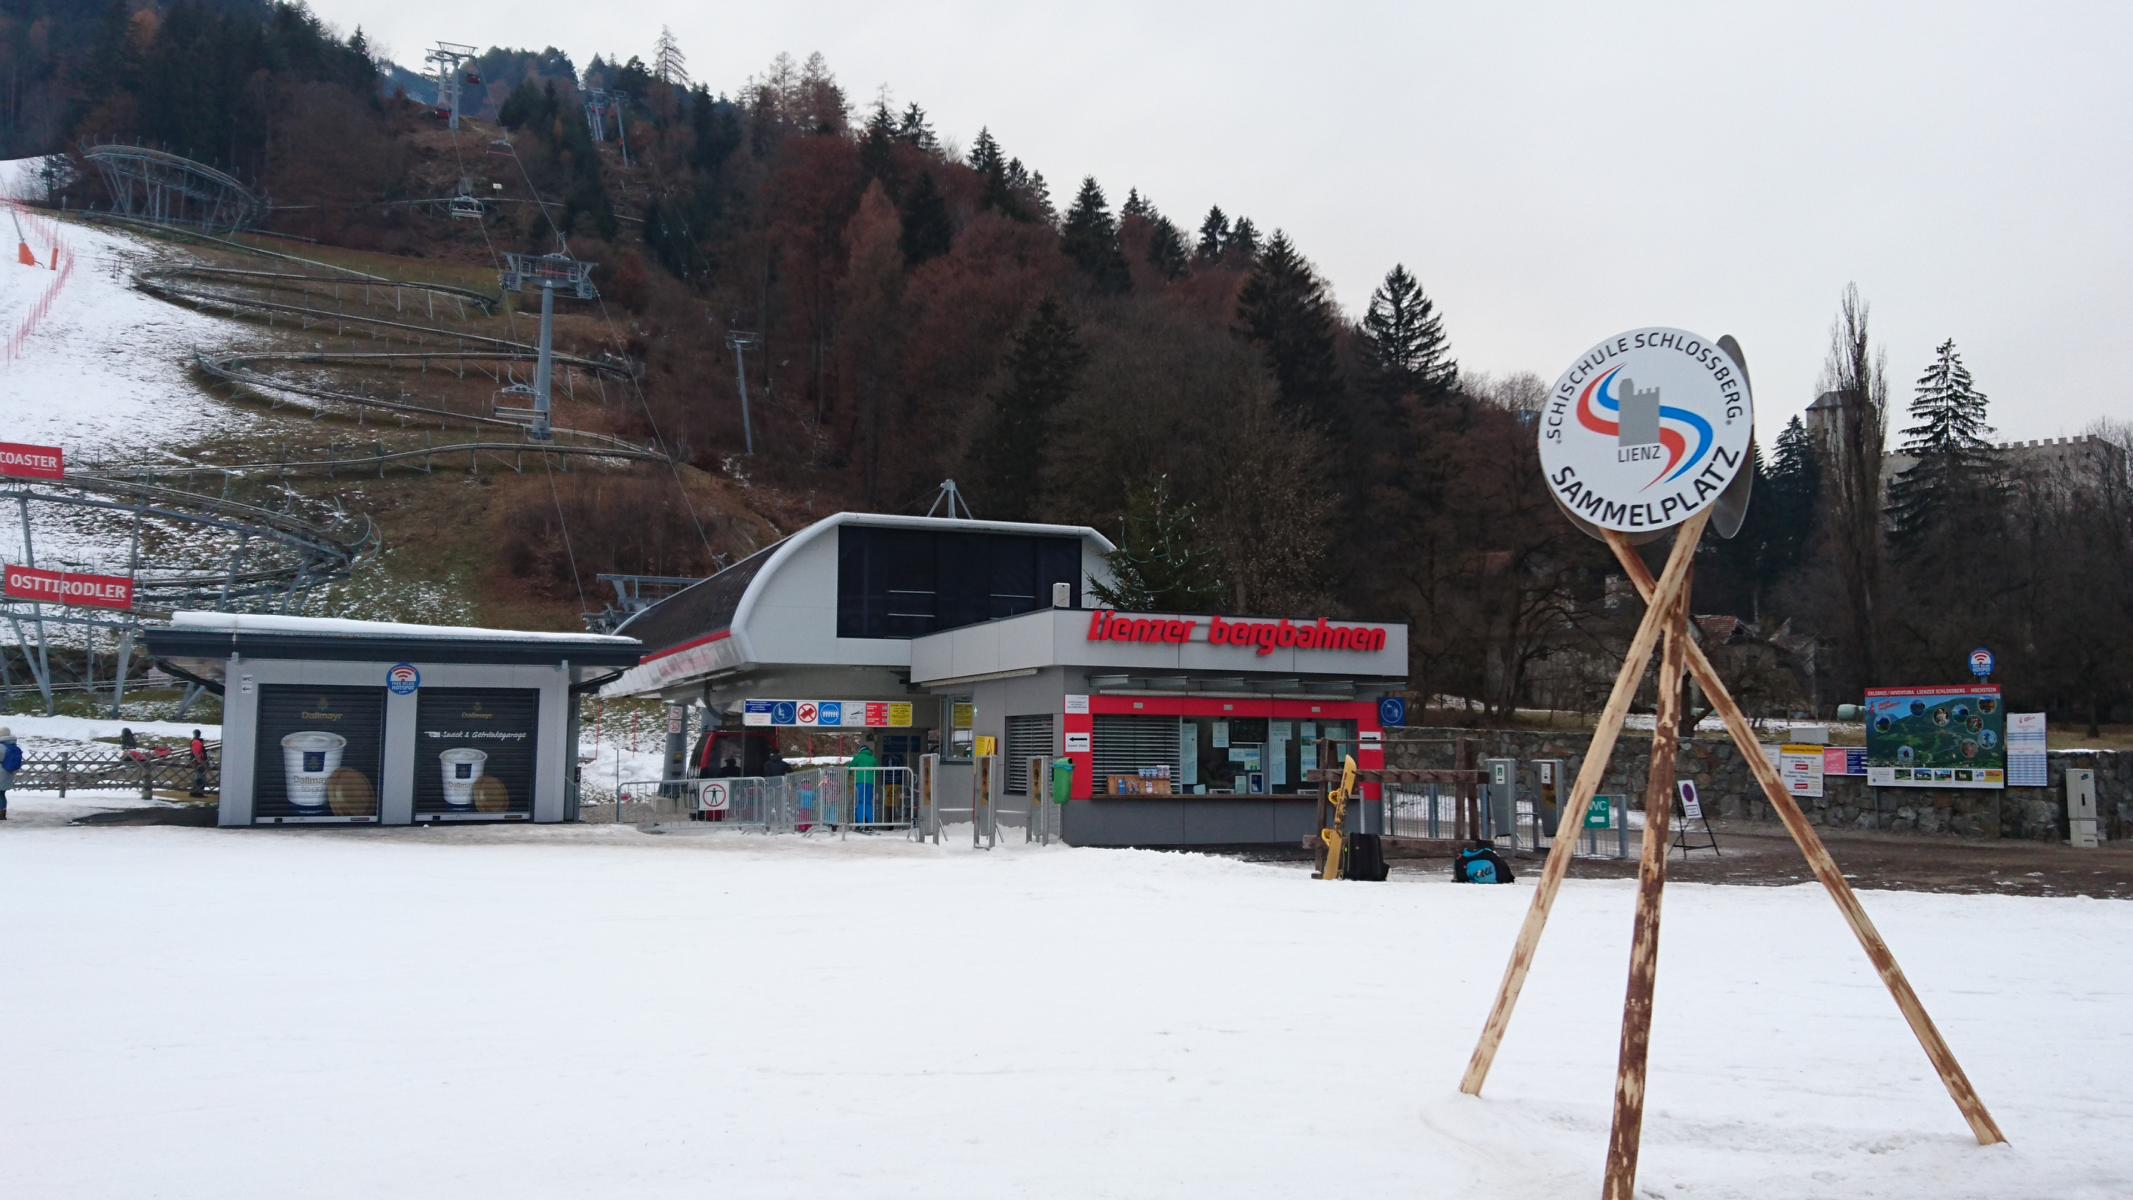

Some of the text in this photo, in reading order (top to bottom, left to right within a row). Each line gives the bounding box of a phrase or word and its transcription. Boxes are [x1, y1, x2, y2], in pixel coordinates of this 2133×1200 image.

[1547, 332, 1743, 442] SCHISCHULE SCHLOSSBERG
[0, 451, 57, 468] COASTER
[1618, 445, 1661, 463] LIENZ
[1551, 446, 1740, 526] SAMMELPLATZ
[10, 573, 126, 599] OSTTIRODLER
[1208, 615, 1387, 656] bergbahnen
[302, 711, 343, 721] Dallmayr
[1588, 800, 1607, 811] WC
